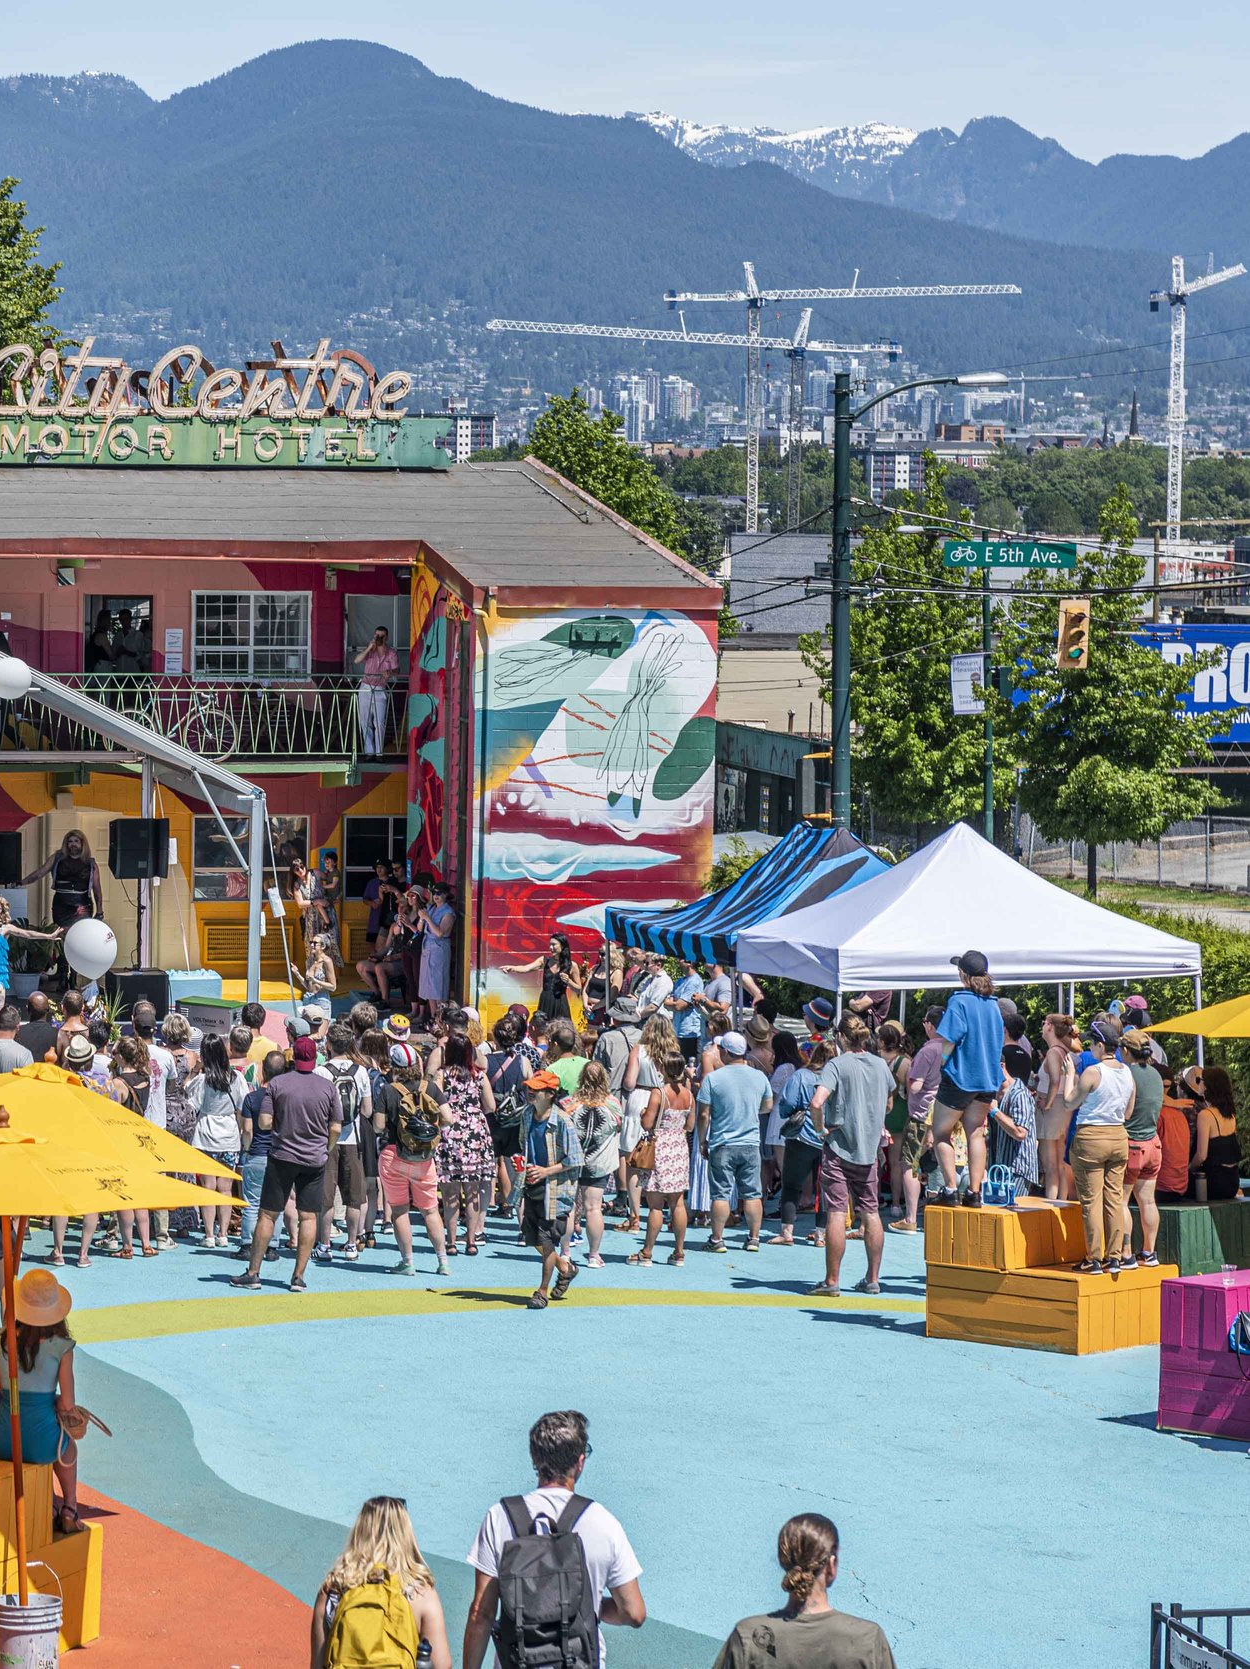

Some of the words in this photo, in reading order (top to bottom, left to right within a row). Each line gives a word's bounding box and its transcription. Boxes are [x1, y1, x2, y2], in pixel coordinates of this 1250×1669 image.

[147, 338, 411, 420] Centre
[0, 423, 174, 461] MOTOR
[215, 425, 377, 462] HOTEL
[985, 547, 993, 562] E
[999, 547, 1024, 563] 5th
[1030, 548, 1062, 564] Ave.
